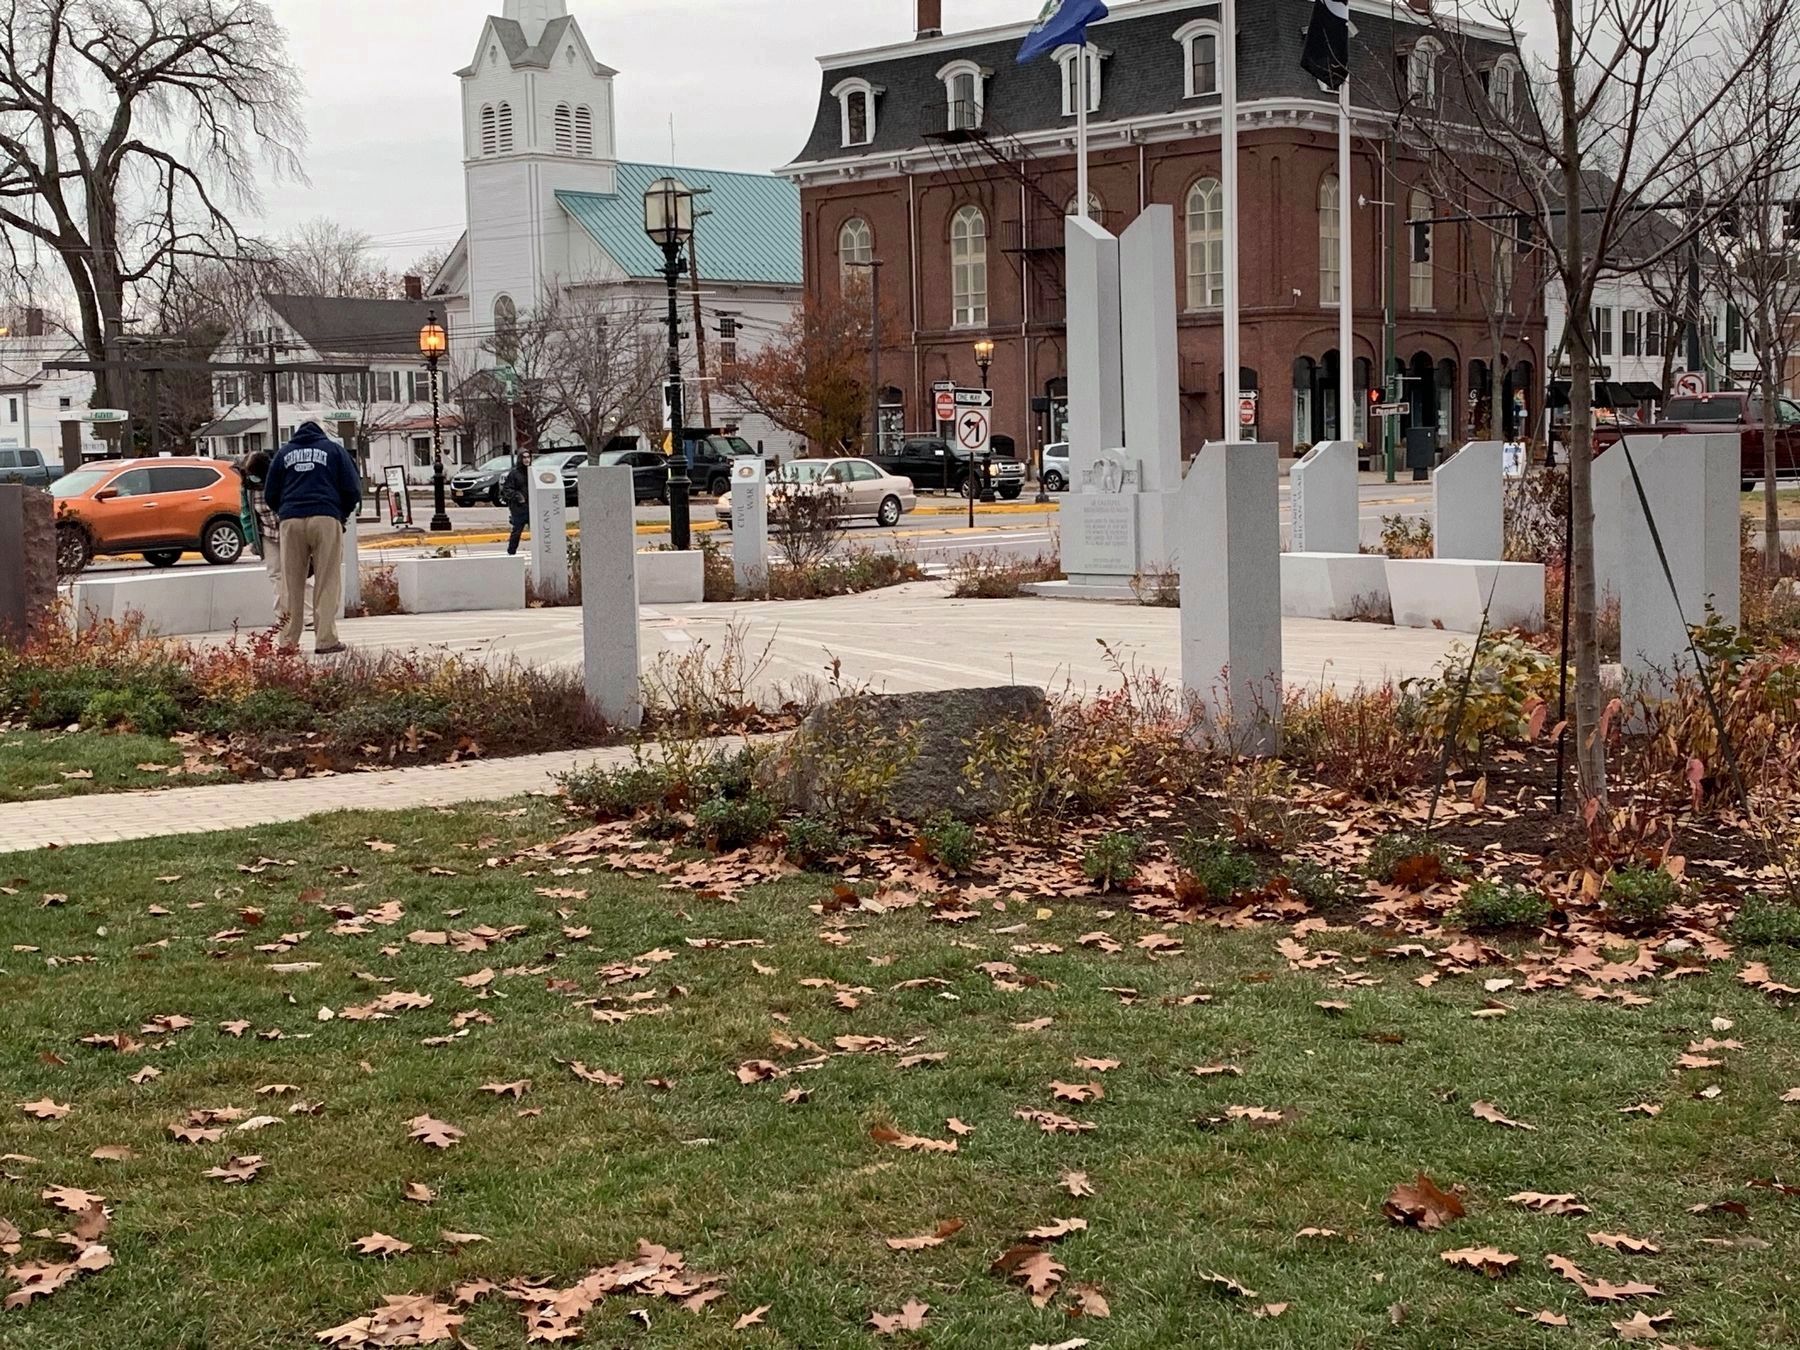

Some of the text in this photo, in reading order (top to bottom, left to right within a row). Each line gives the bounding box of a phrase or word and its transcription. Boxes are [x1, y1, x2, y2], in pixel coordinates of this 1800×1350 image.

[313, 448, 328, 467] BEACH
[552, 494, 560, 516] WAR
[746, 488, 754, 510] WAR
[737, 505, 745, 528] CIVIL
[543, 510, 552, 553] MEXICAN
